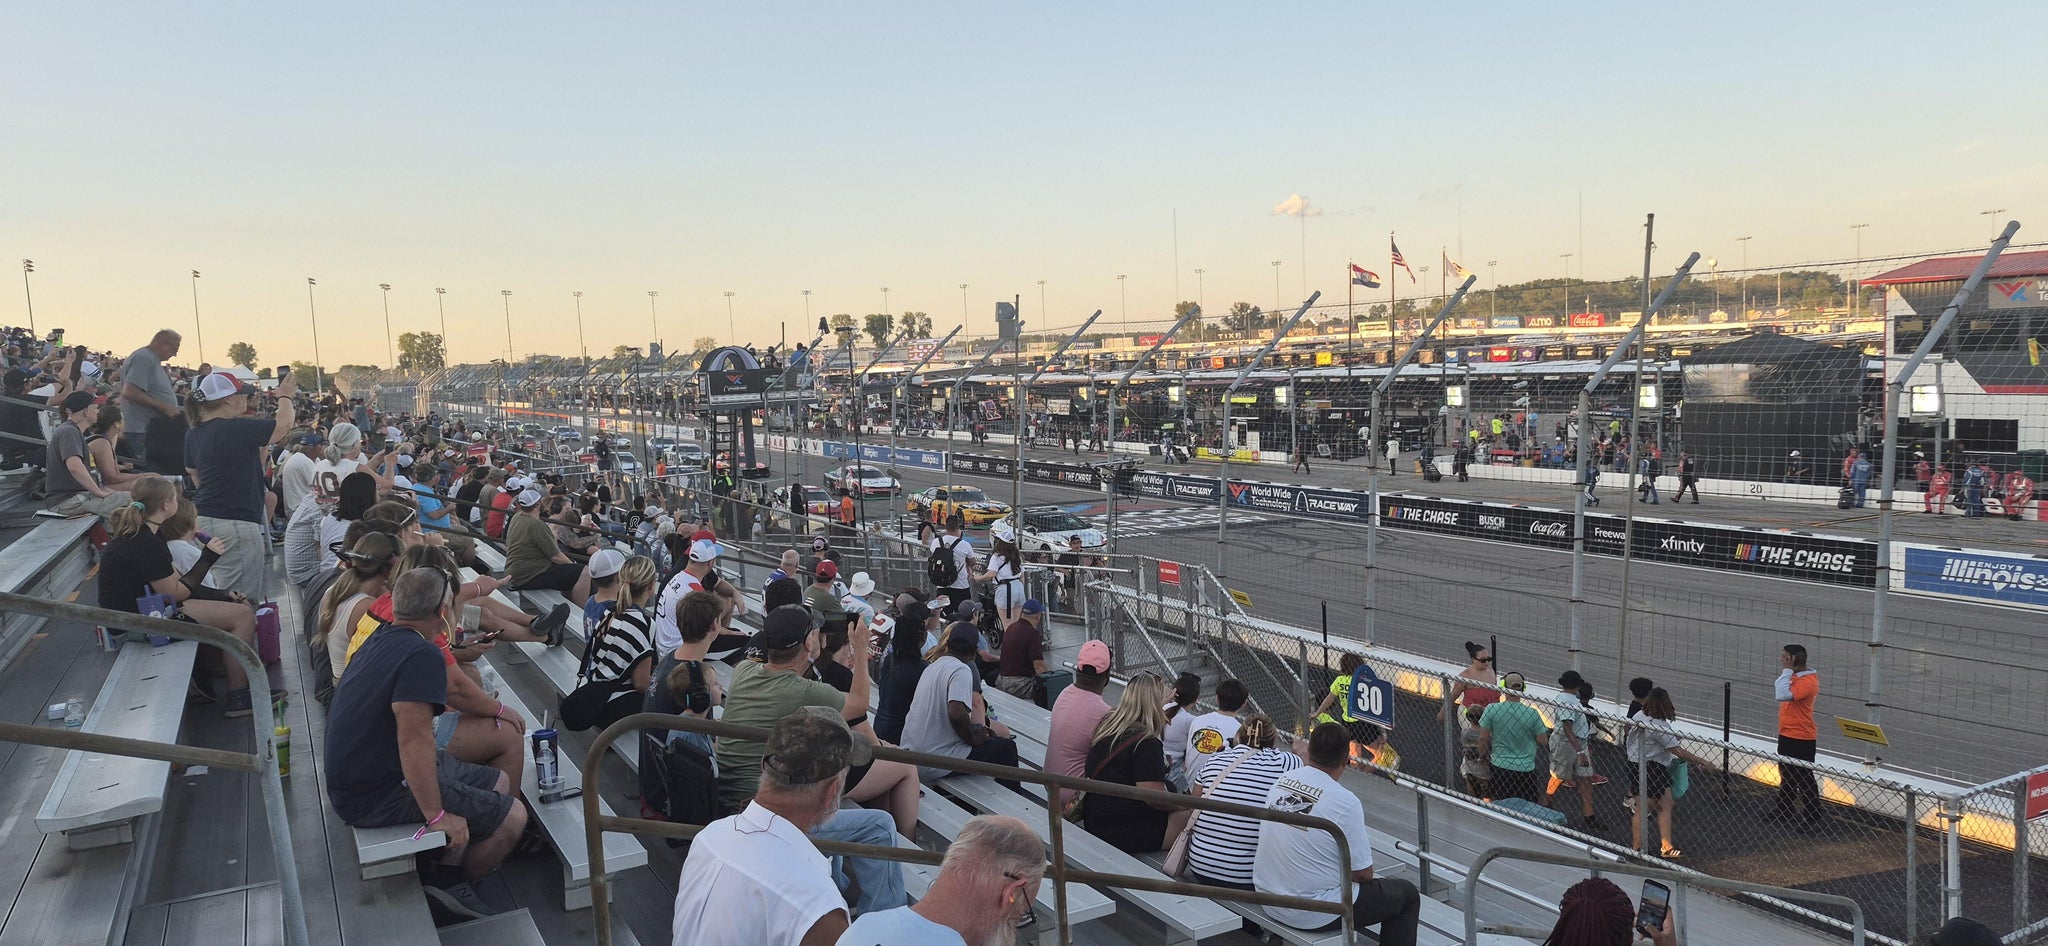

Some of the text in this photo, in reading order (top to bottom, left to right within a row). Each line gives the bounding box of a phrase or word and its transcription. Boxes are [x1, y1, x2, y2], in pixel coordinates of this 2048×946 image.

[1065, 471, 1092, 484] THE CHASE
[1133, 474, 1163, 485] World Wide
[1176, 485, 1213, 496] RACEWAY
[1251, 485, 1291, 499] World Wide
[1750, 483, 1763, 494] 20
[1251, 496, 1291, 512] Technology
[1309, 499, 1358, 513] RACEWAY
[1403, 507, 1459, 526] THE CHASE
[1479, 515, 1505, 529] BUSCH
[1594, 528, 1626, 540] Freewa
[1661, 535, 1704, 555] xfinity
[1759, 545, 1856, 573] THE CHASE
[1977, 561, 2014, 571] ENJOY
[1357, 682, 1383, 716] 30
[1279, 775, 1324, 798] Carhartt
